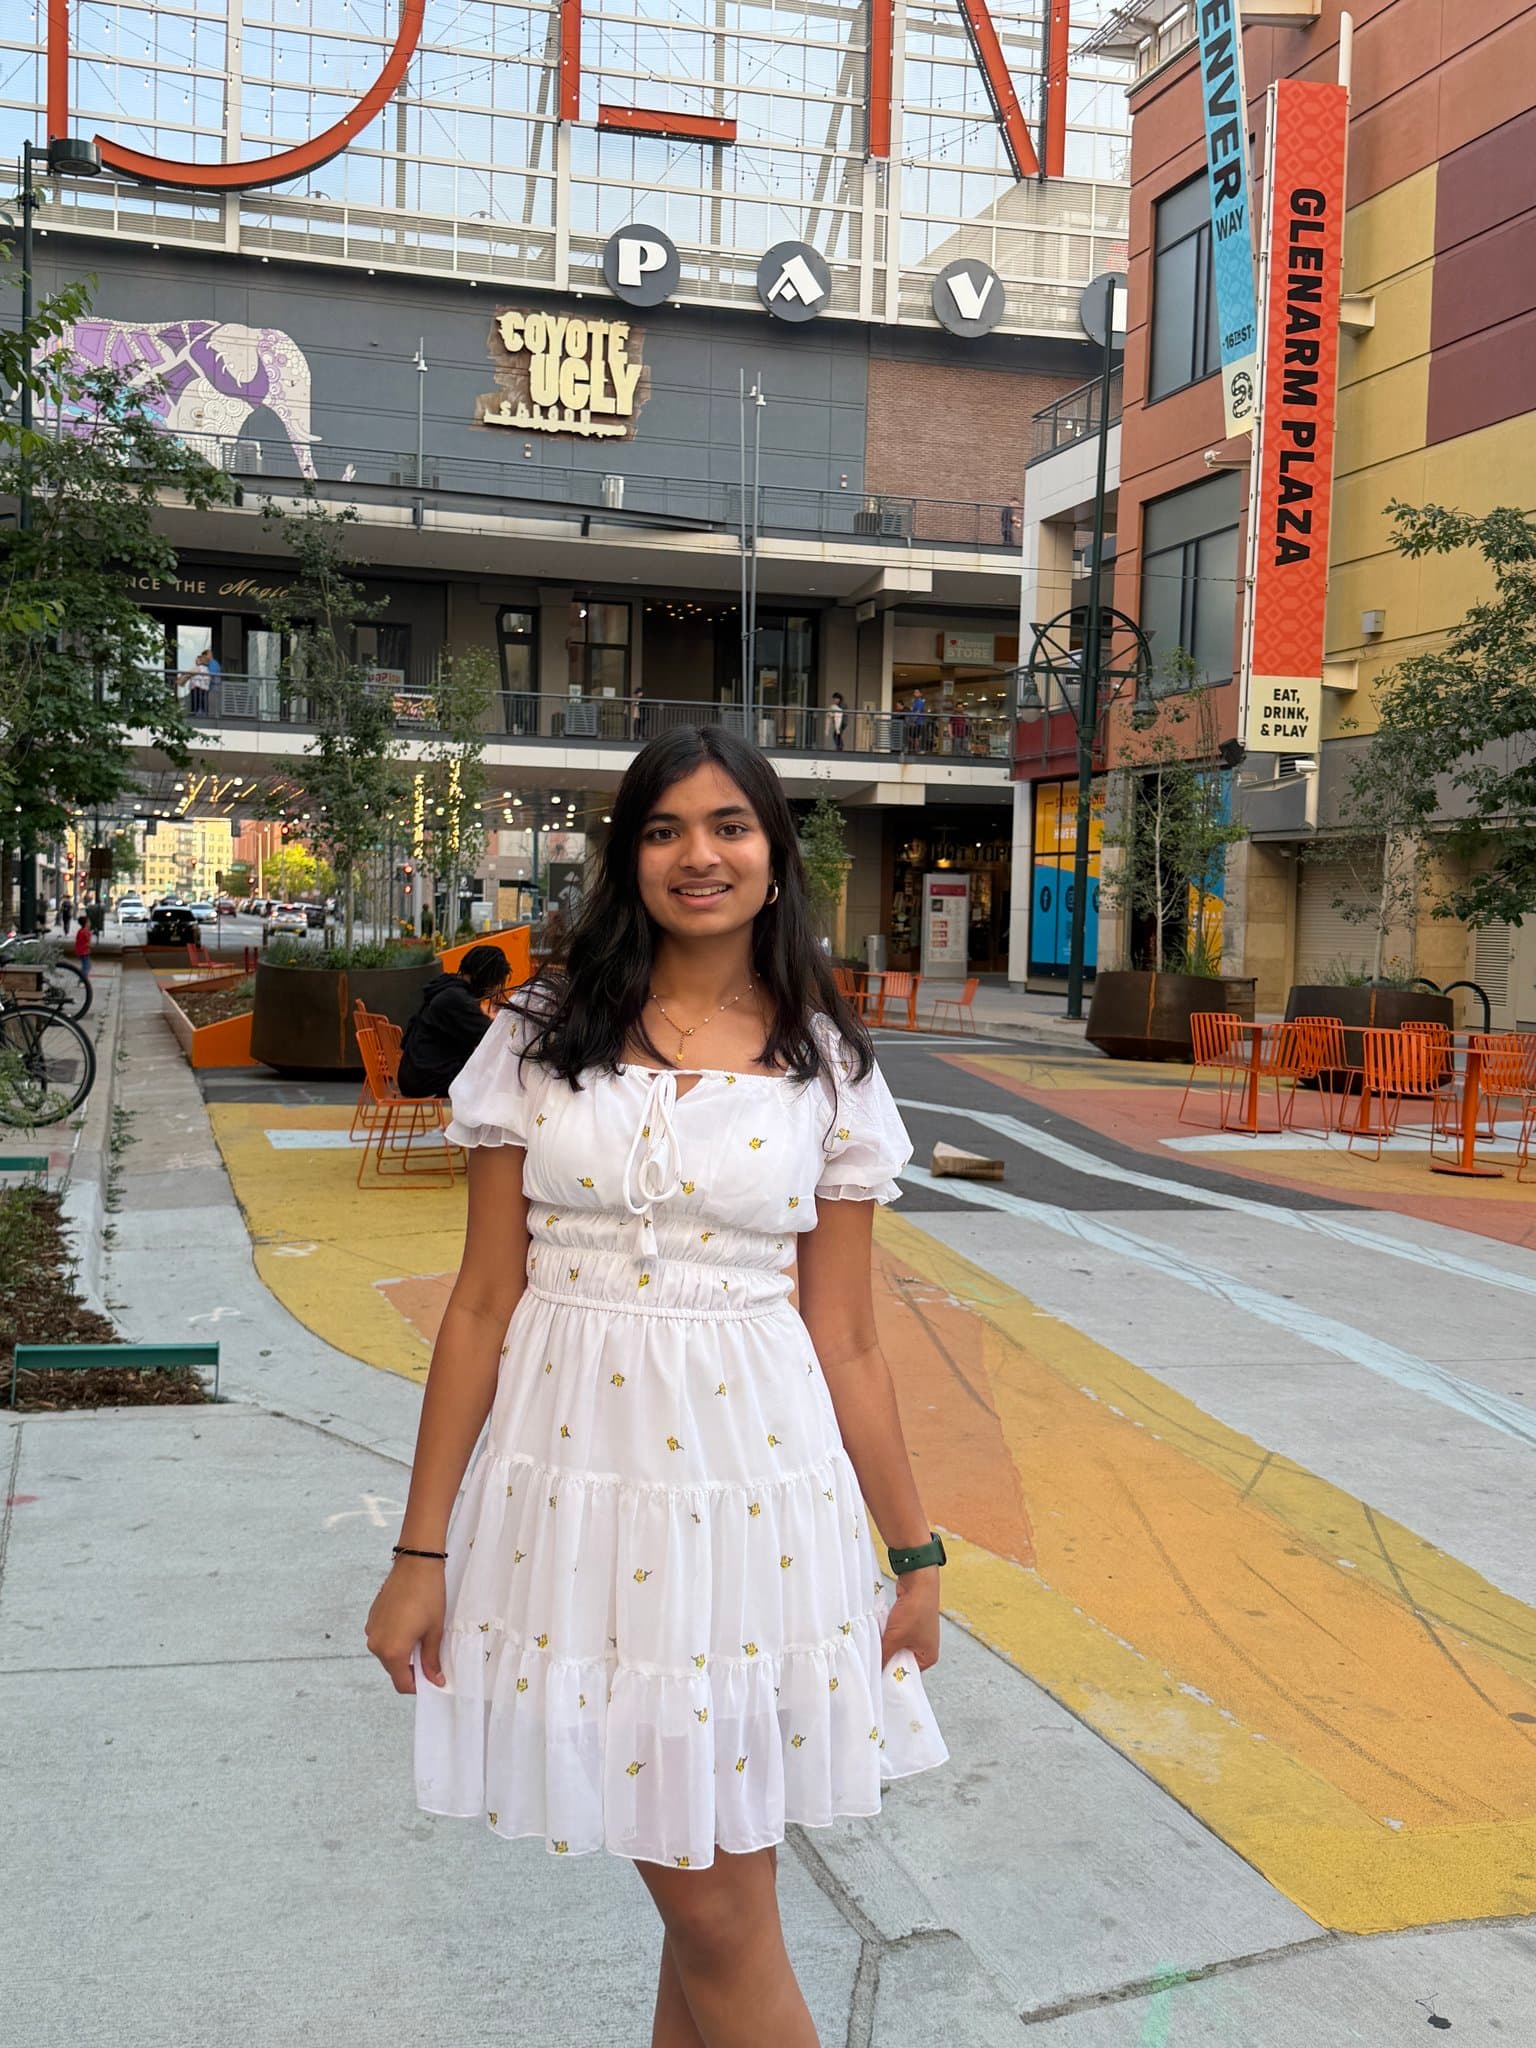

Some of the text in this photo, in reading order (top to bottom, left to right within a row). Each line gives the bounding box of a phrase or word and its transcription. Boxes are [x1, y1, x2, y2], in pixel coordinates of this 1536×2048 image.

[1216, 204, 1245, 242] WAY
[496, 311, 631, 365] COYOTE
[529, 353, 643, 416] UGLY
[1275, 187, 1326, 567] GLENARM PLAZA
[499, 401, 592, 425] SALOON
[175, 580, 207, 594] THE
[1273, 688, 1300, 704] EAT,
[1264, 706, 1309, 722] DRINK,
[1260, 723, 1308, 738] & PLAY
